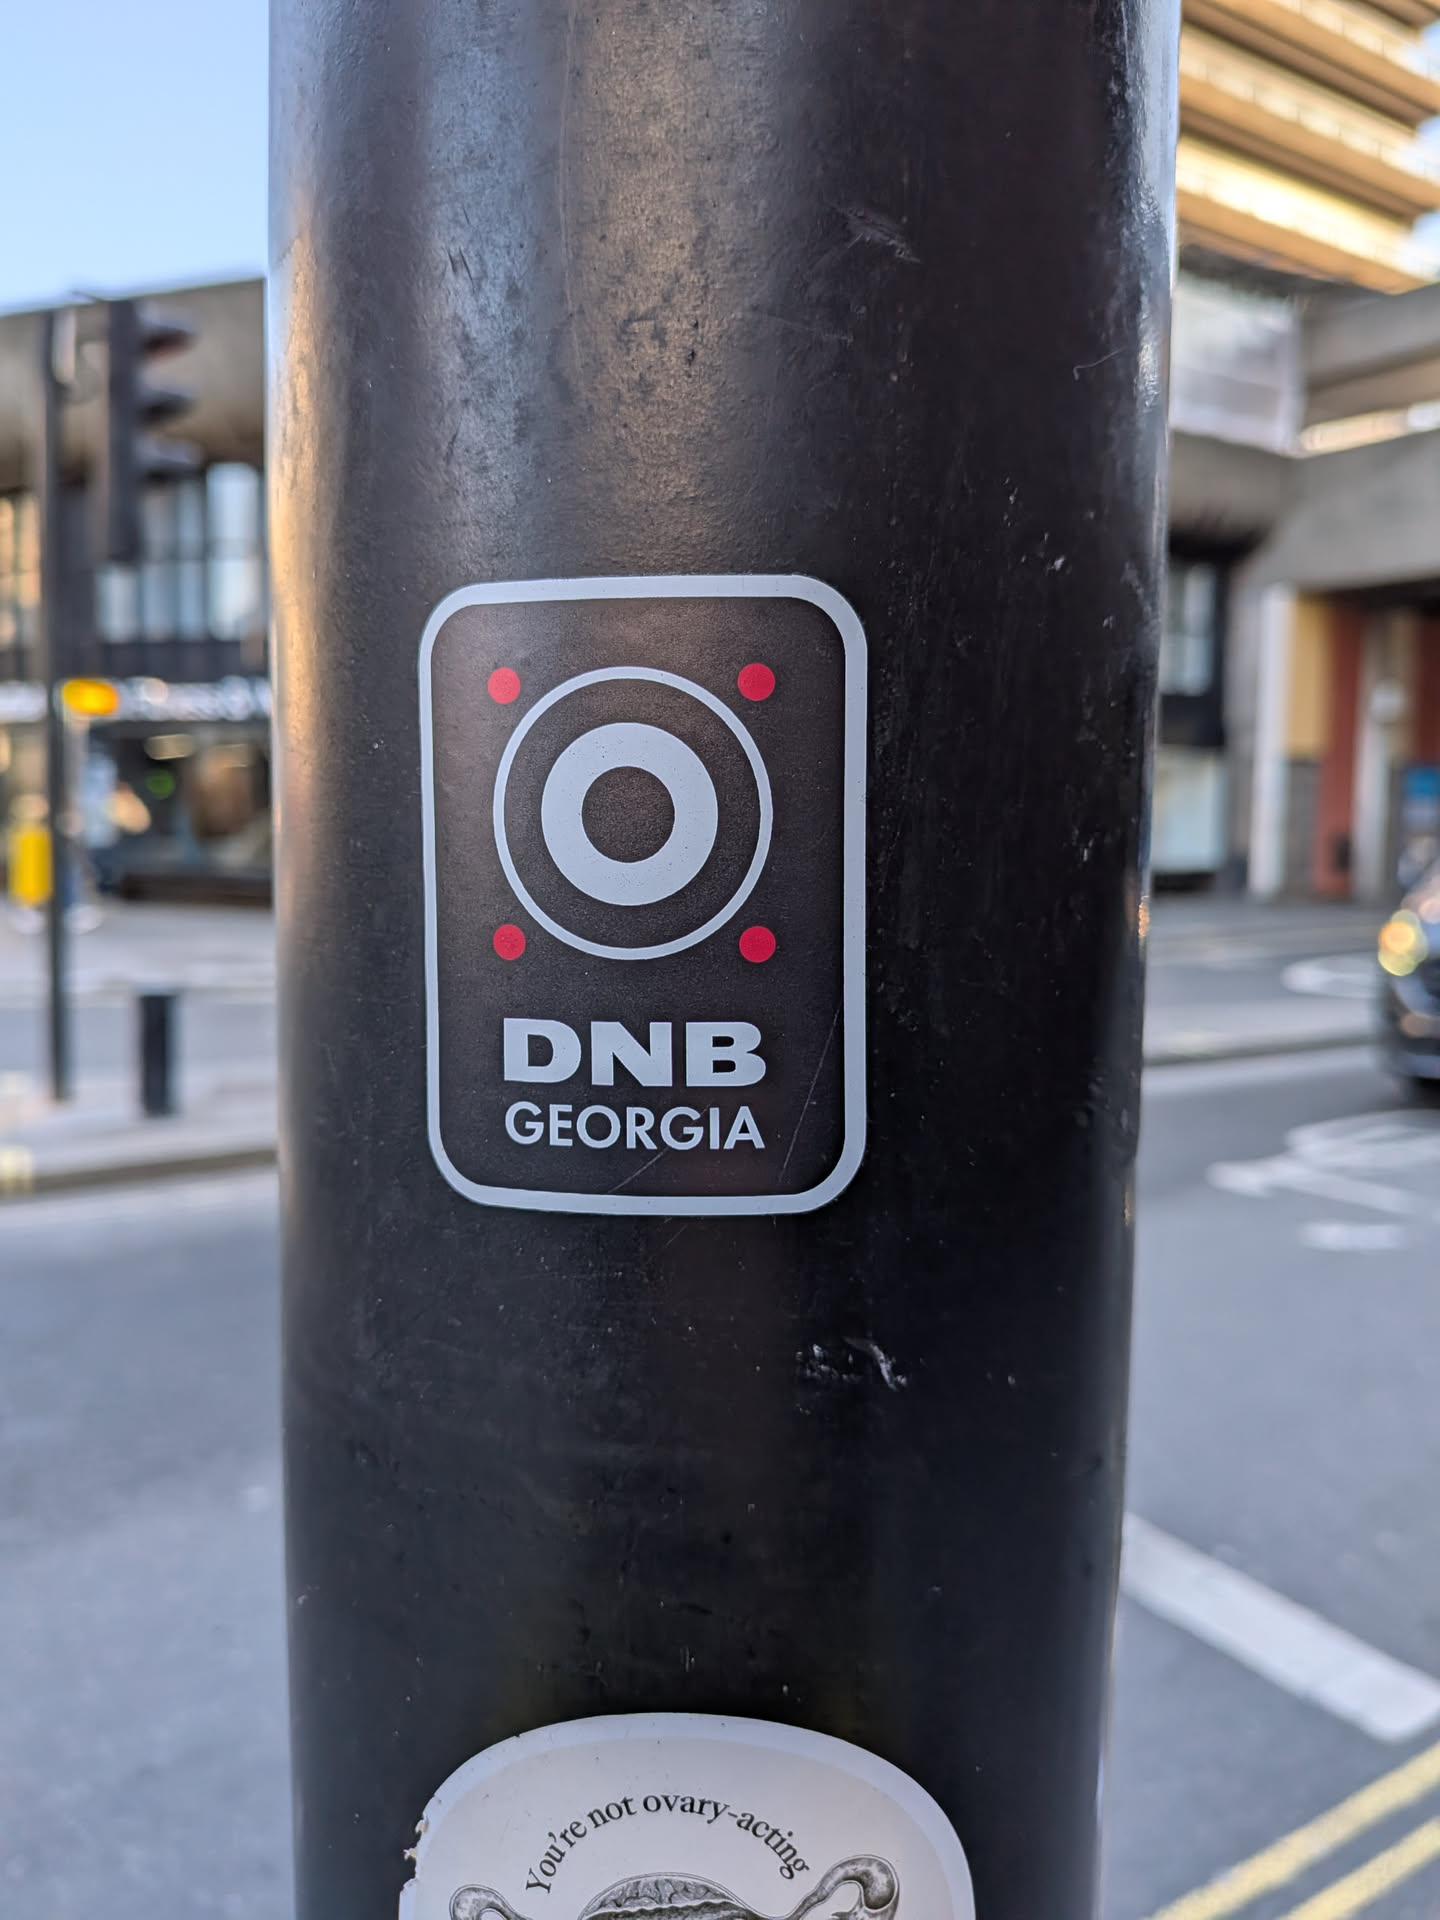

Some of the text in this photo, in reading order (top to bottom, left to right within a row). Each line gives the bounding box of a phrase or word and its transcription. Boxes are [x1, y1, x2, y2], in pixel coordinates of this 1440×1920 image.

[503, 1017, 767, 1087] DNB
[504, 1100, 766, 1151] GEORGIA
[525, 1794, 810, 1894] You're not ovary-acting
